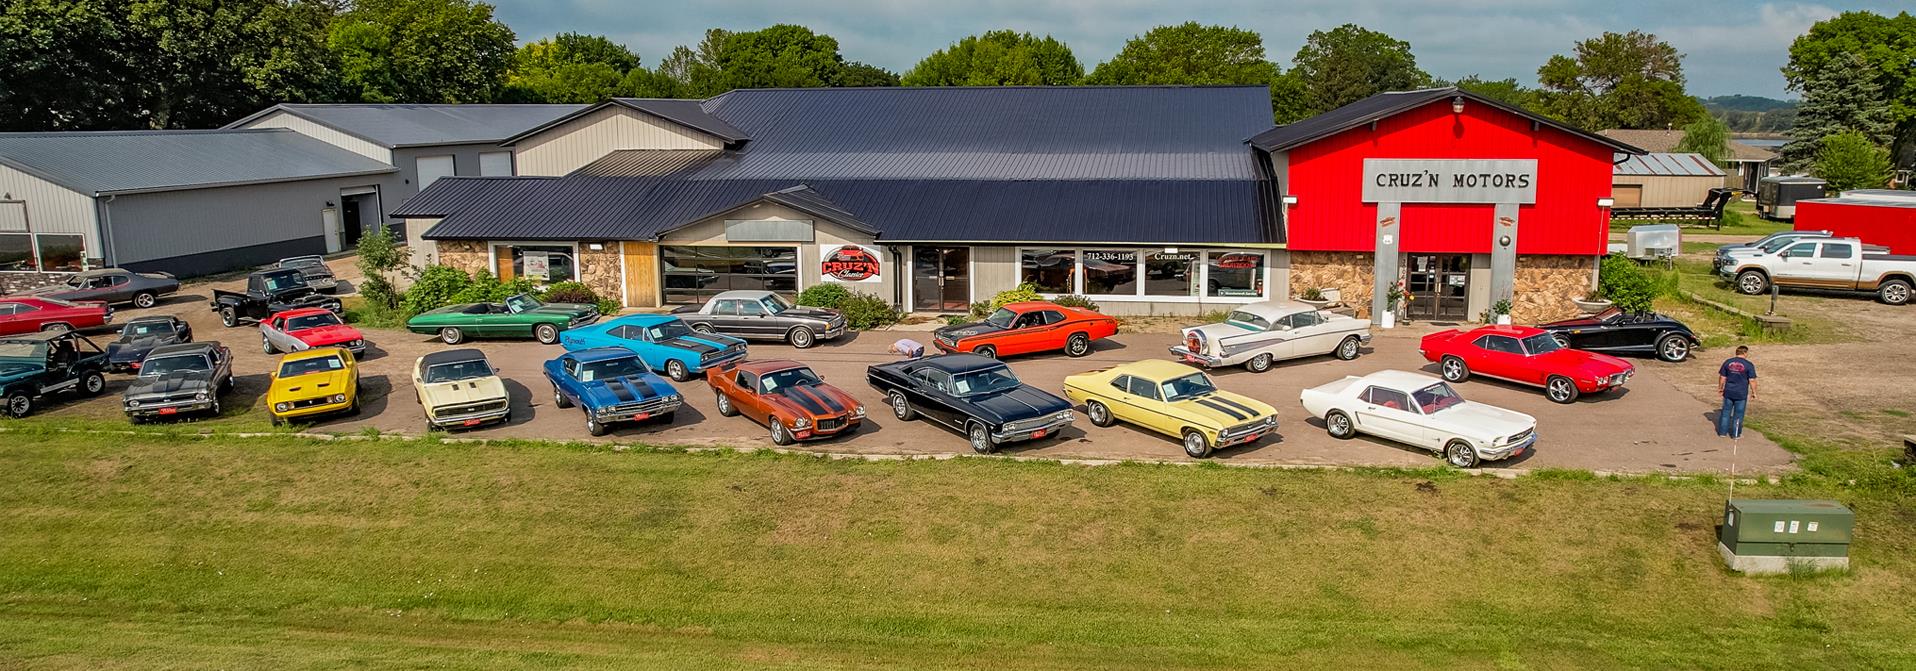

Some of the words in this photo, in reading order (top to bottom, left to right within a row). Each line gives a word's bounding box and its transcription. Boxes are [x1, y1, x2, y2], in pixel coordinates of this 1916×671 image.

[1376, 170, 1439, 187] CRUZ'N
[1453, 173, 1530, 188] MOTORS
[1087, 252, 1134, 261] 712-336-1193
[822, 261, 879, 275] CRUZ'N
